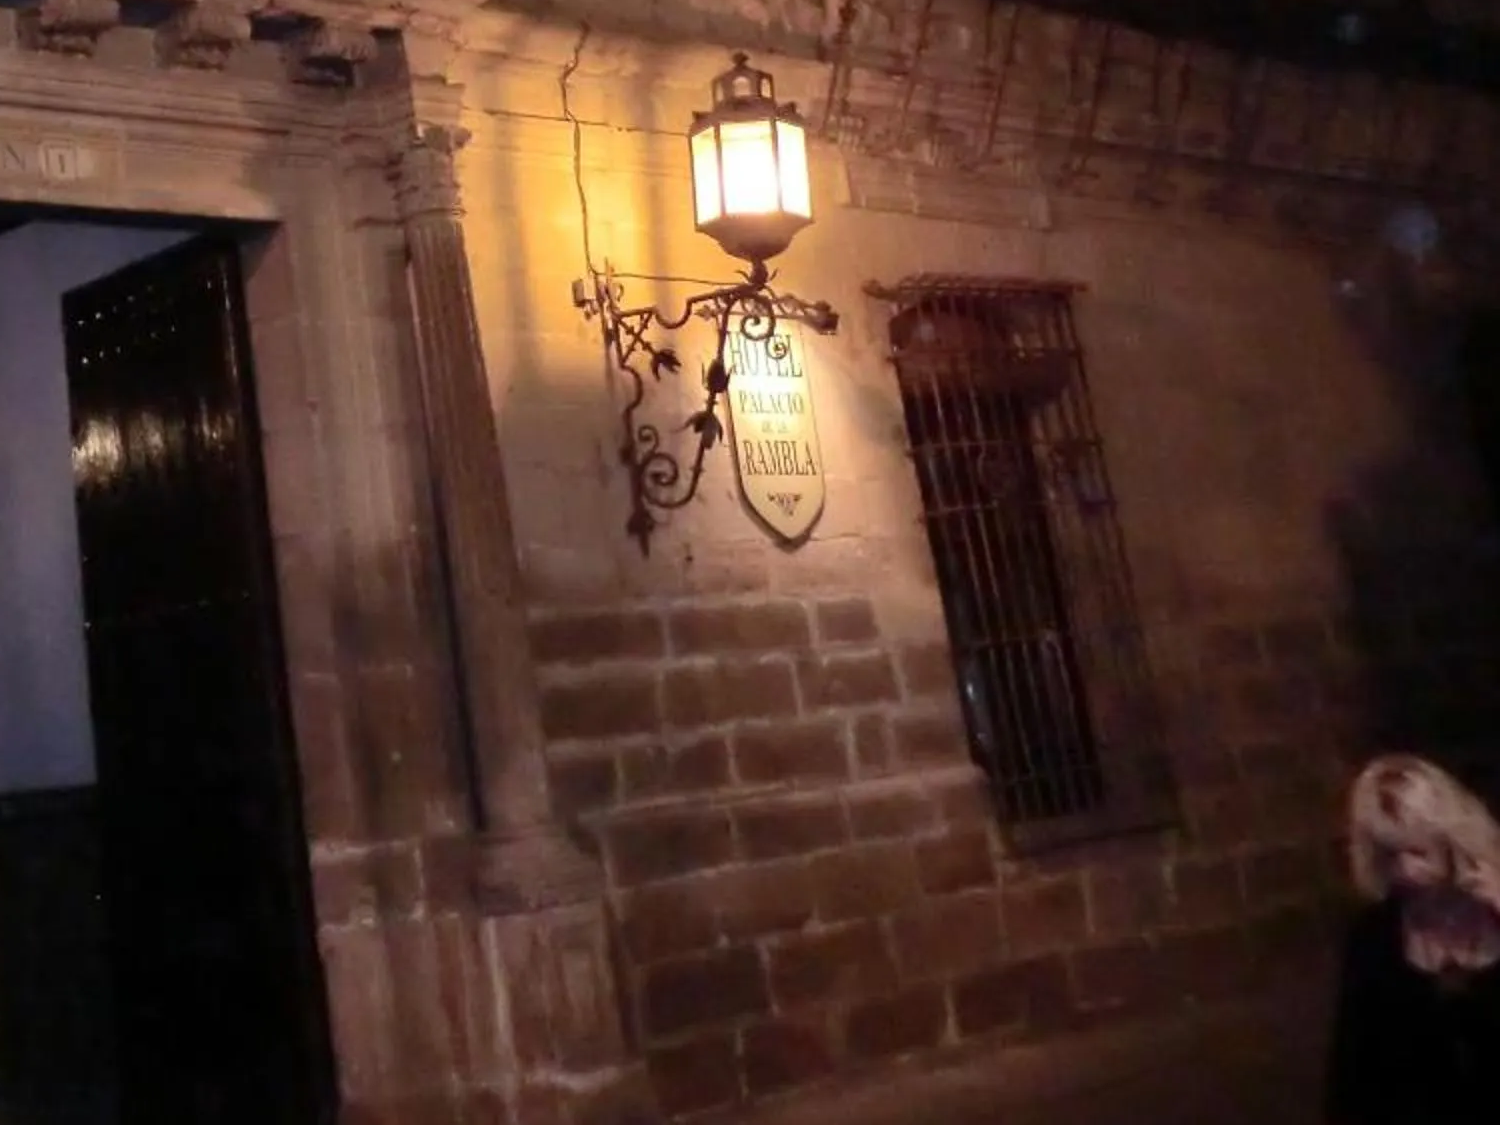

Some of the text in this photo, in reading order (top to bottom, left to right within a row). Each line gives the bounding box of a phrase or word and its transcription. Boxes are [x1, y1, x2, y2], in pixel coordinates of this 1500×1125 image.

[726, 330, 803, 378] HOTEL
[738, 389, 805, 416] PALACIO
[742, 439, 817, 476] RAMBLA
